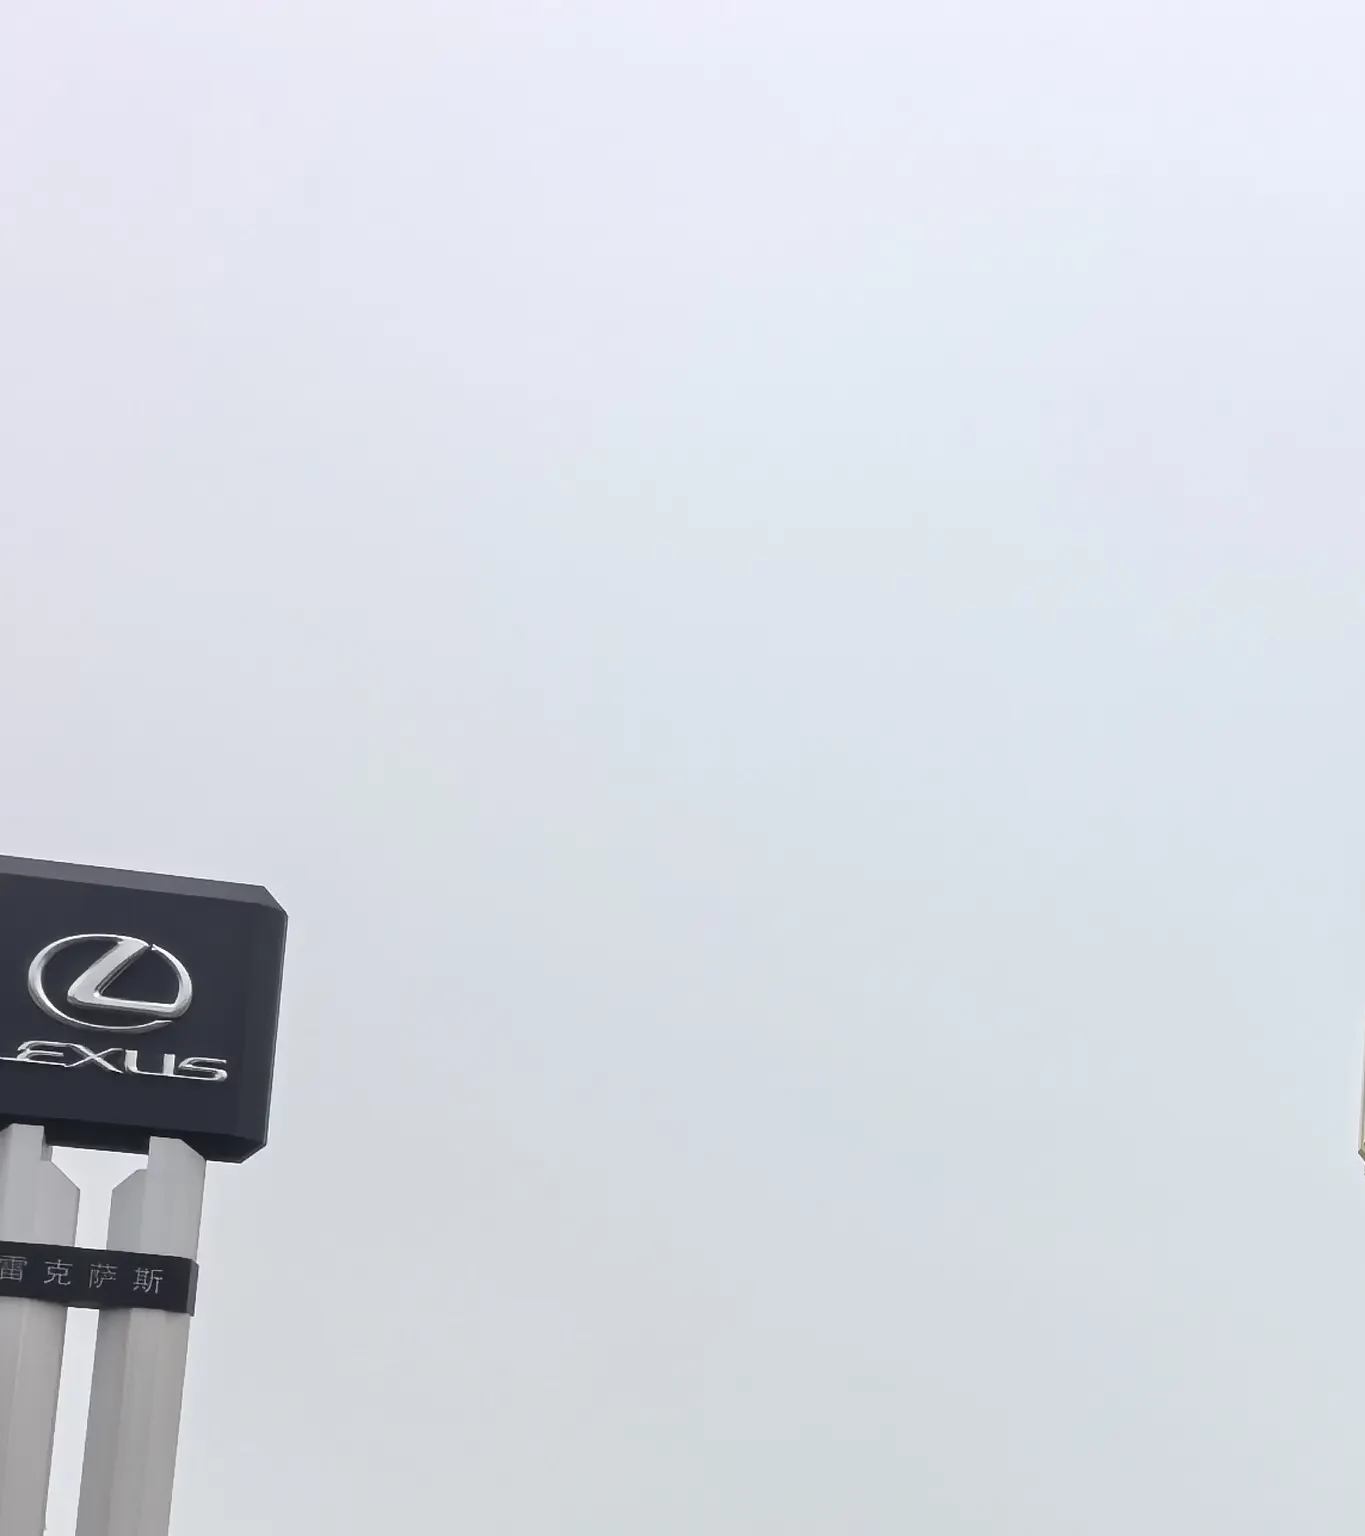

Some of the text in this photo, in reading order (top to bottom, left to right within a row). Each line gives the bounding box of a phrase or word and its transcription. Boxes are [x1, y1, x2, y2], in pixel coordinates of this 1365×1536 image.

[0, 1040, 229, 1081] EXUS
[0, 1254, 164, 1294] 雷克萨斯
